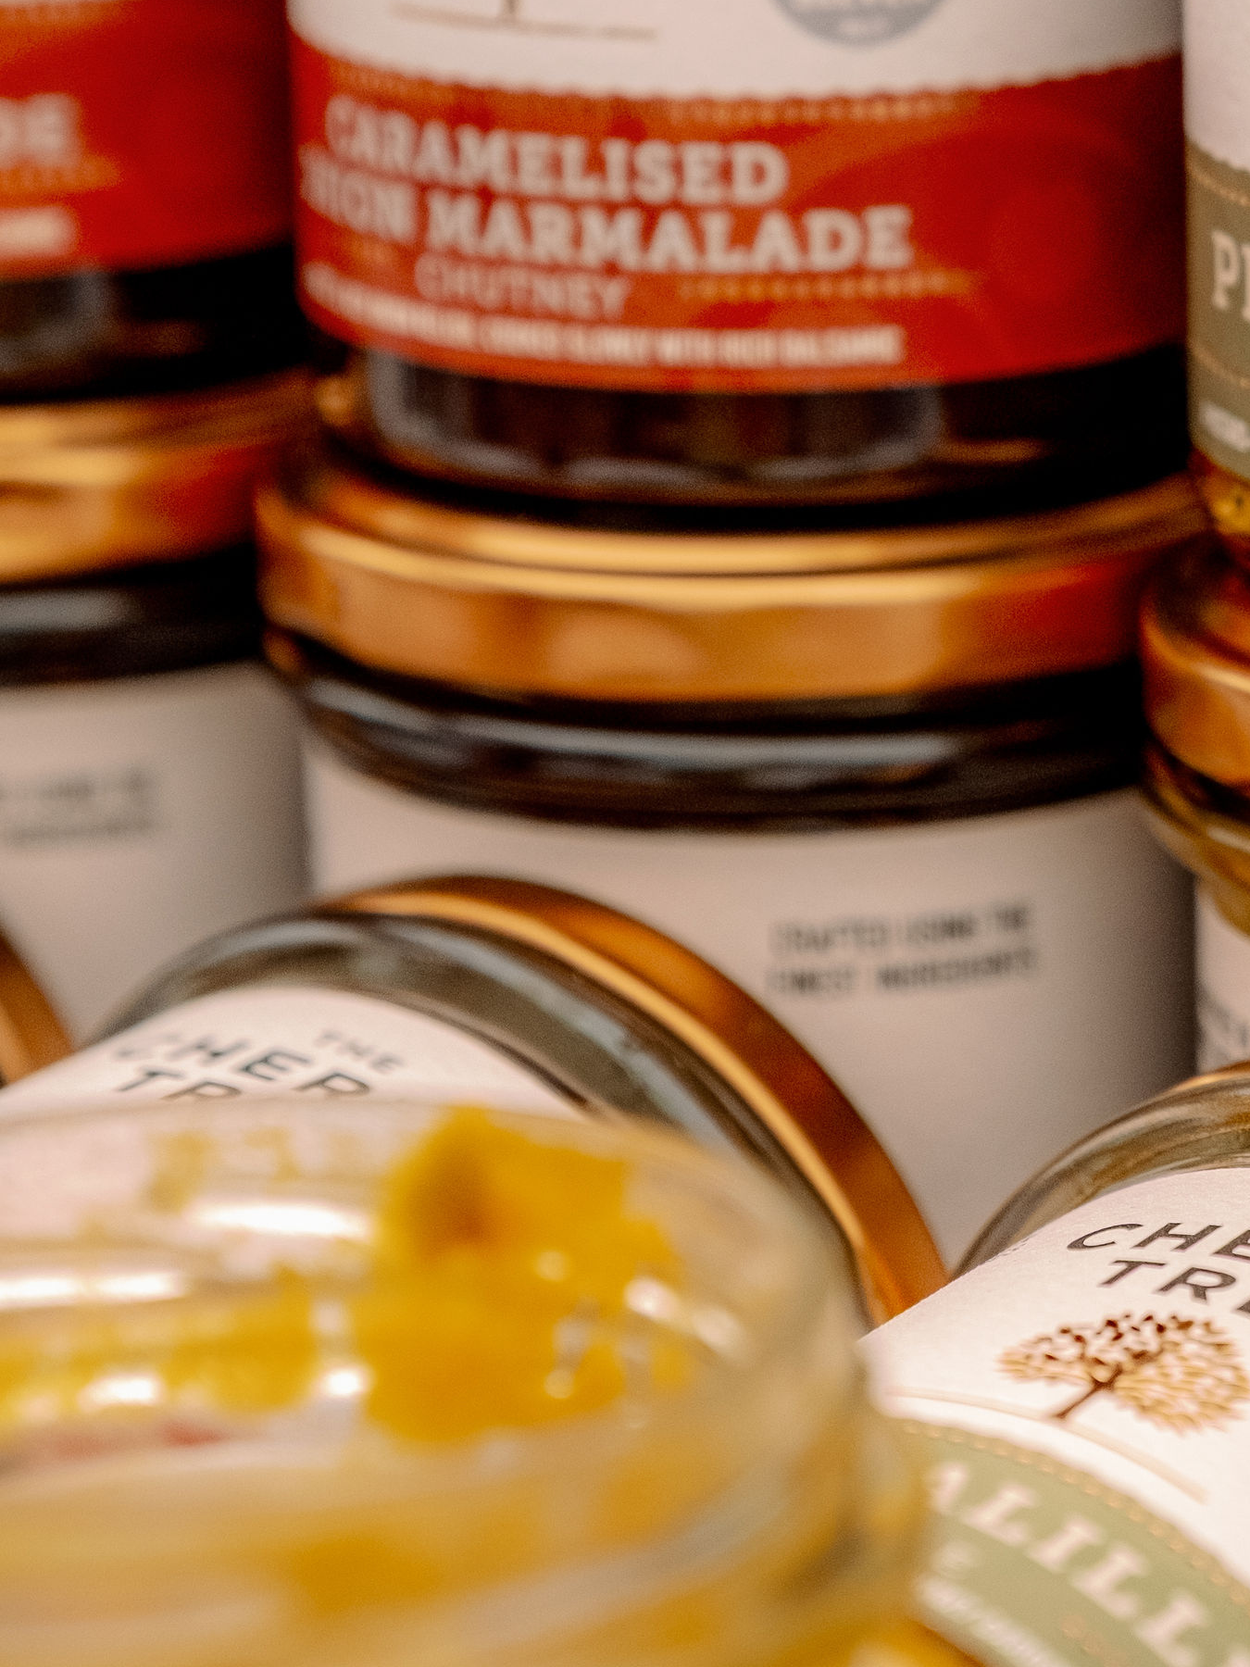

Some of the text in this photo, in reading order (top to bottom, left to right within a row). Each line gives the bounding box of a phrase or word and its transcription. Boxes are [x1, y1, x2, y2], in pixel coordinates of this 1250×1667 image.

[323, 93, 790, 206] CARAMELISED
[424, 192, 915, 275] MARMALADE
[413, 253, 631, 320] CHUTNEY
